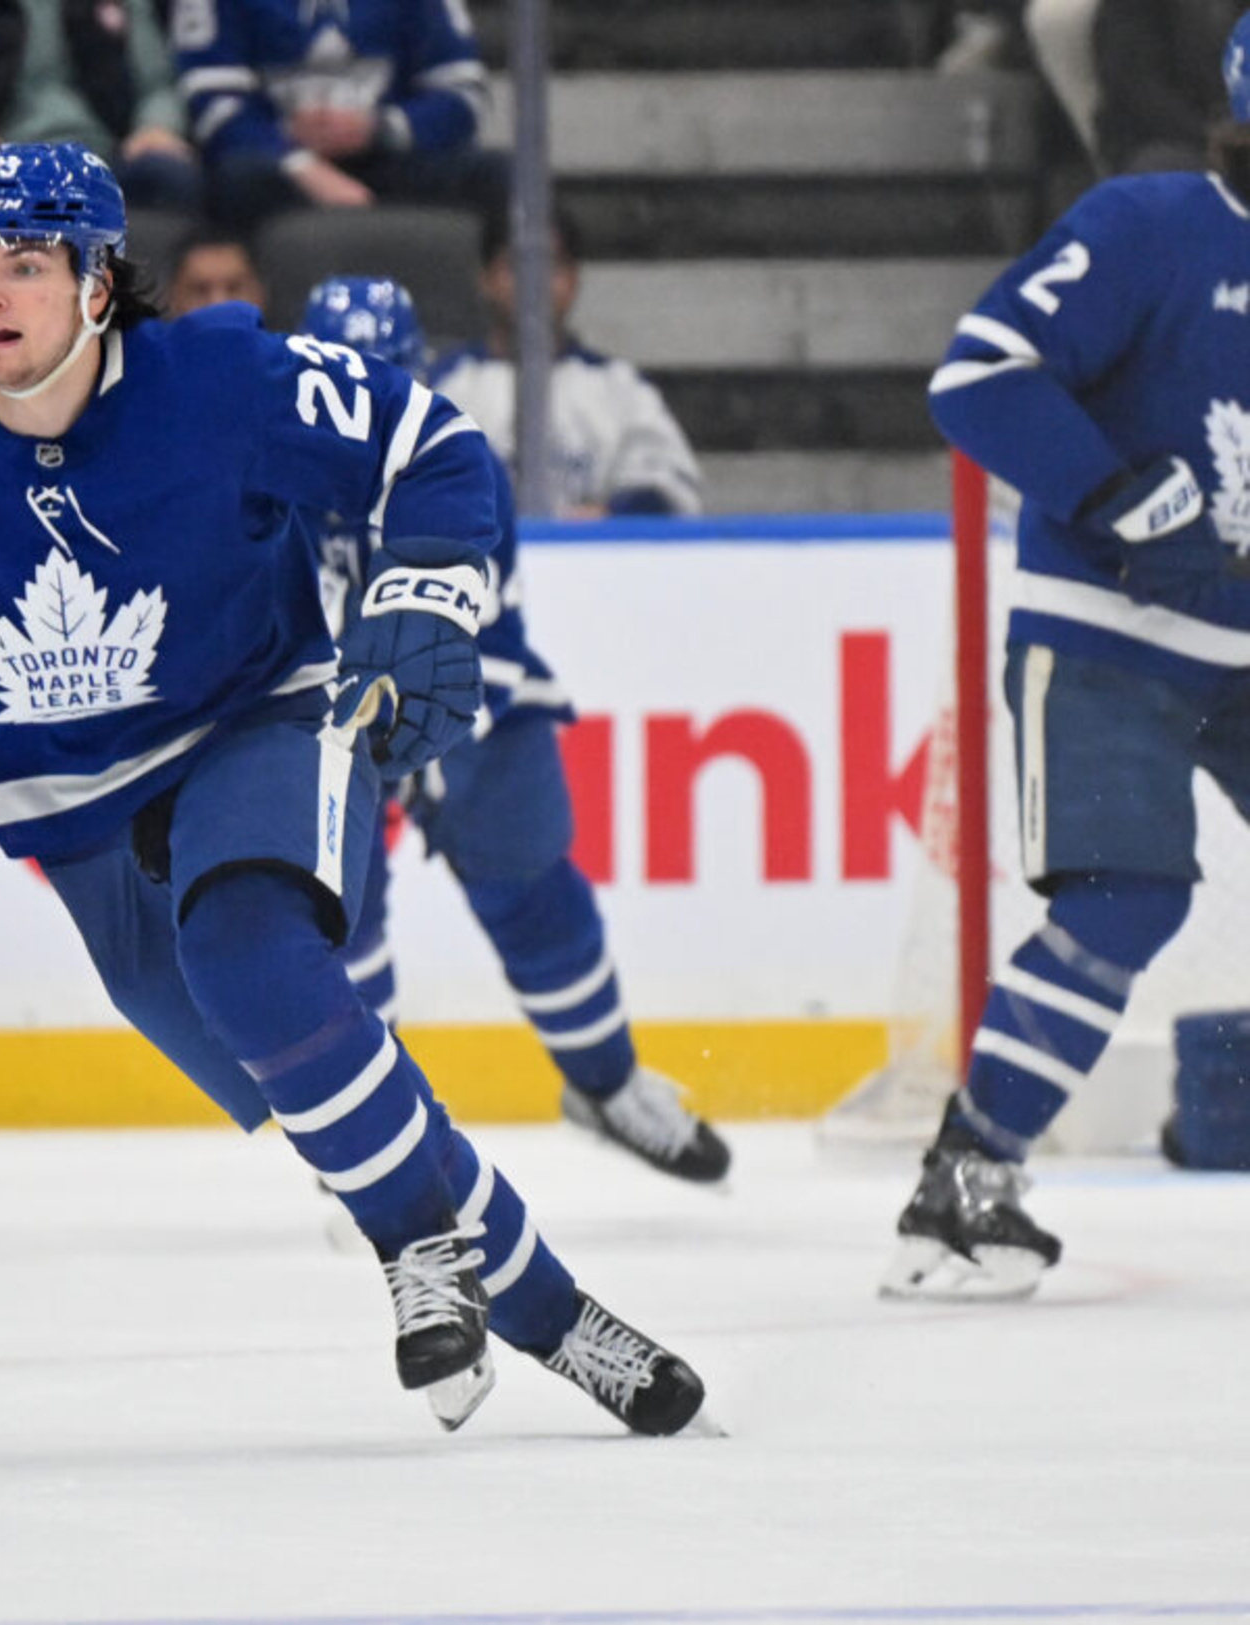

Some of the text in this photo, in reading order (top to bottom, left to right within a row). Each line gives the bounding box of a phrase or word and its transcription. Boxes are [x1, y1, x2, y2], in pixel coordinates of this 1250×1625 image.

[1018, 241, 1090, 315] 2
[285, 333, 372, 442] 23
[374, 577, 481, 619] CCM
[2, 645, 139, 677] TORONTO
[27, 670, 121, 693] MAPLE
[29, 689, 123, 709] LEAFS
